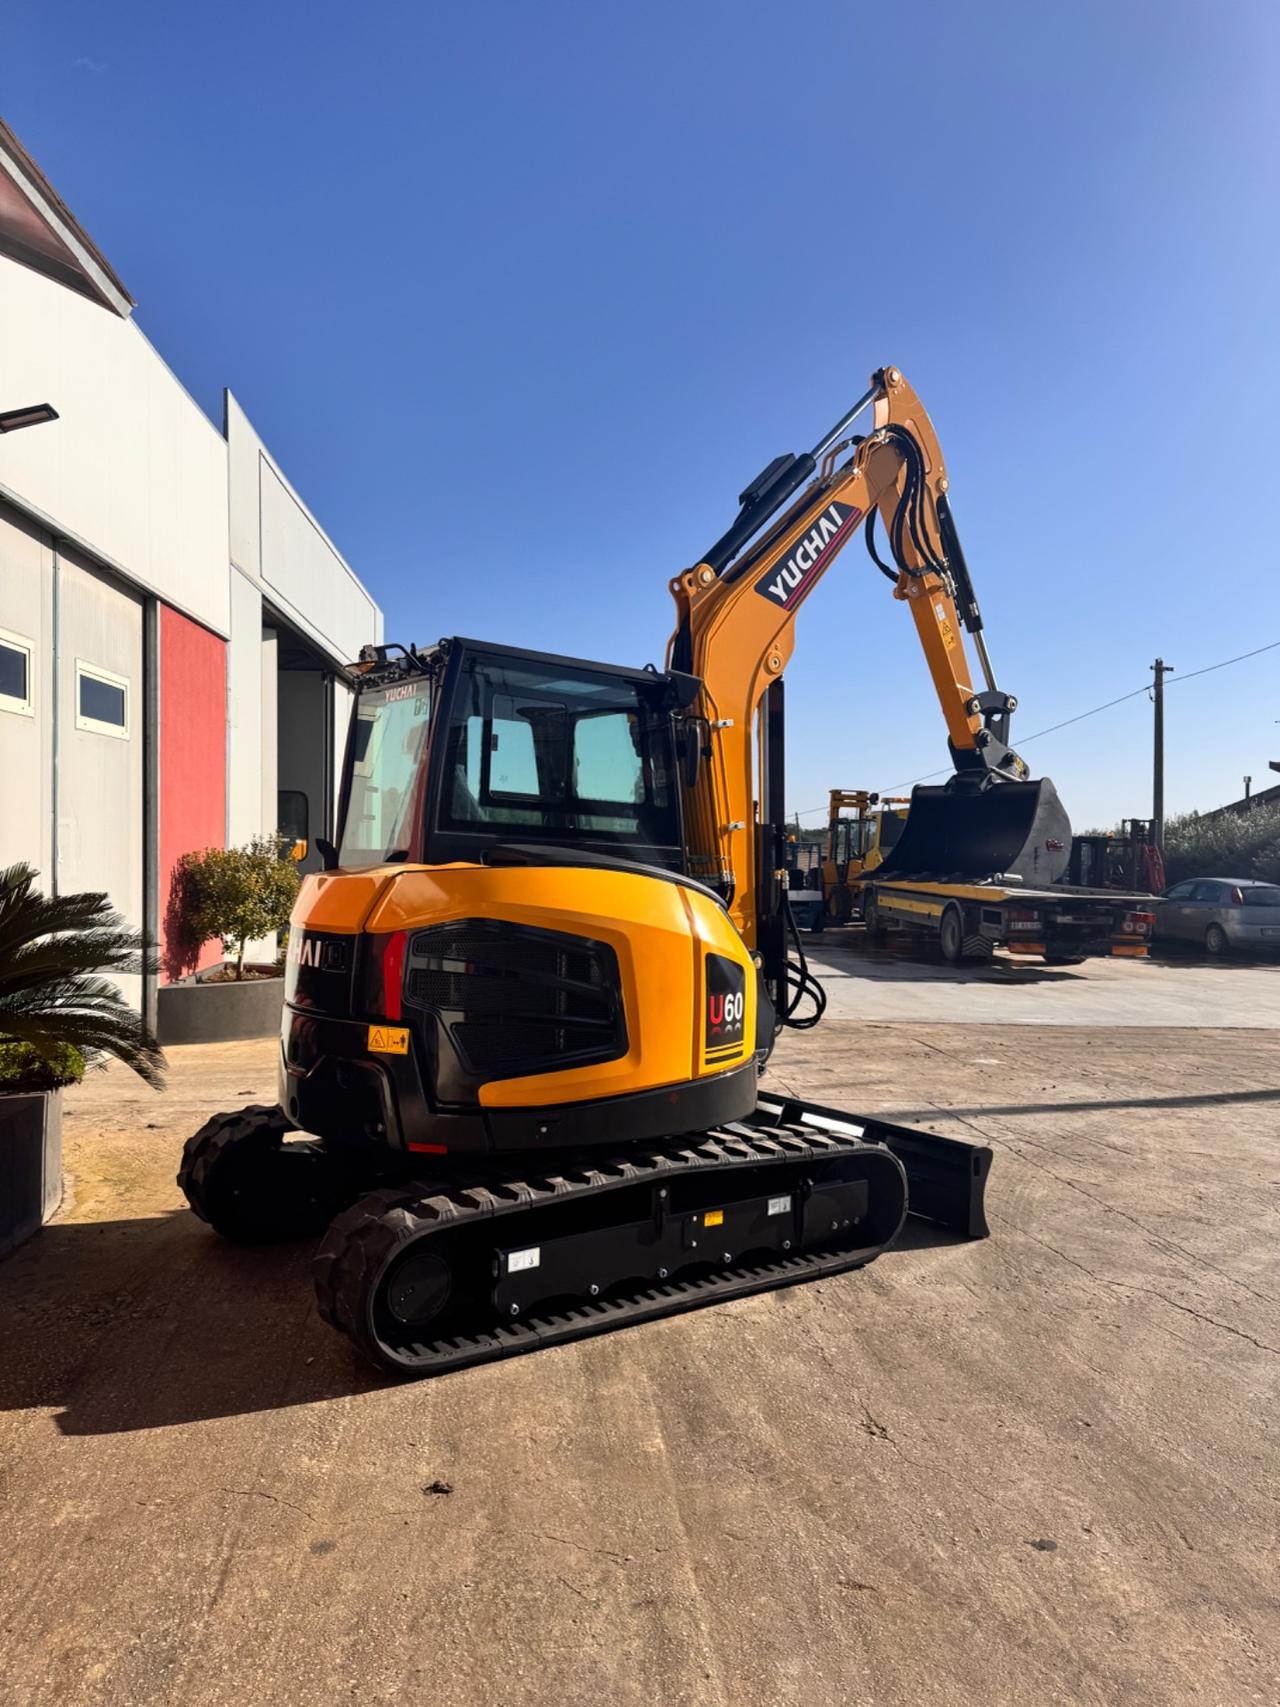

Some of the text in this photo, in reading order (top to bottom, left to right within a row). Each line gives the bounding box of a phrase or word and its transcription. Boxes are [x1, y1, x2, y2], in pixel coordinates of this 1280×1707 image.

[768, 504, 843, 602] YUCHAI
[384, 683, 417, 703] YUCHAI
[709, 992, 743, 1025] U60
